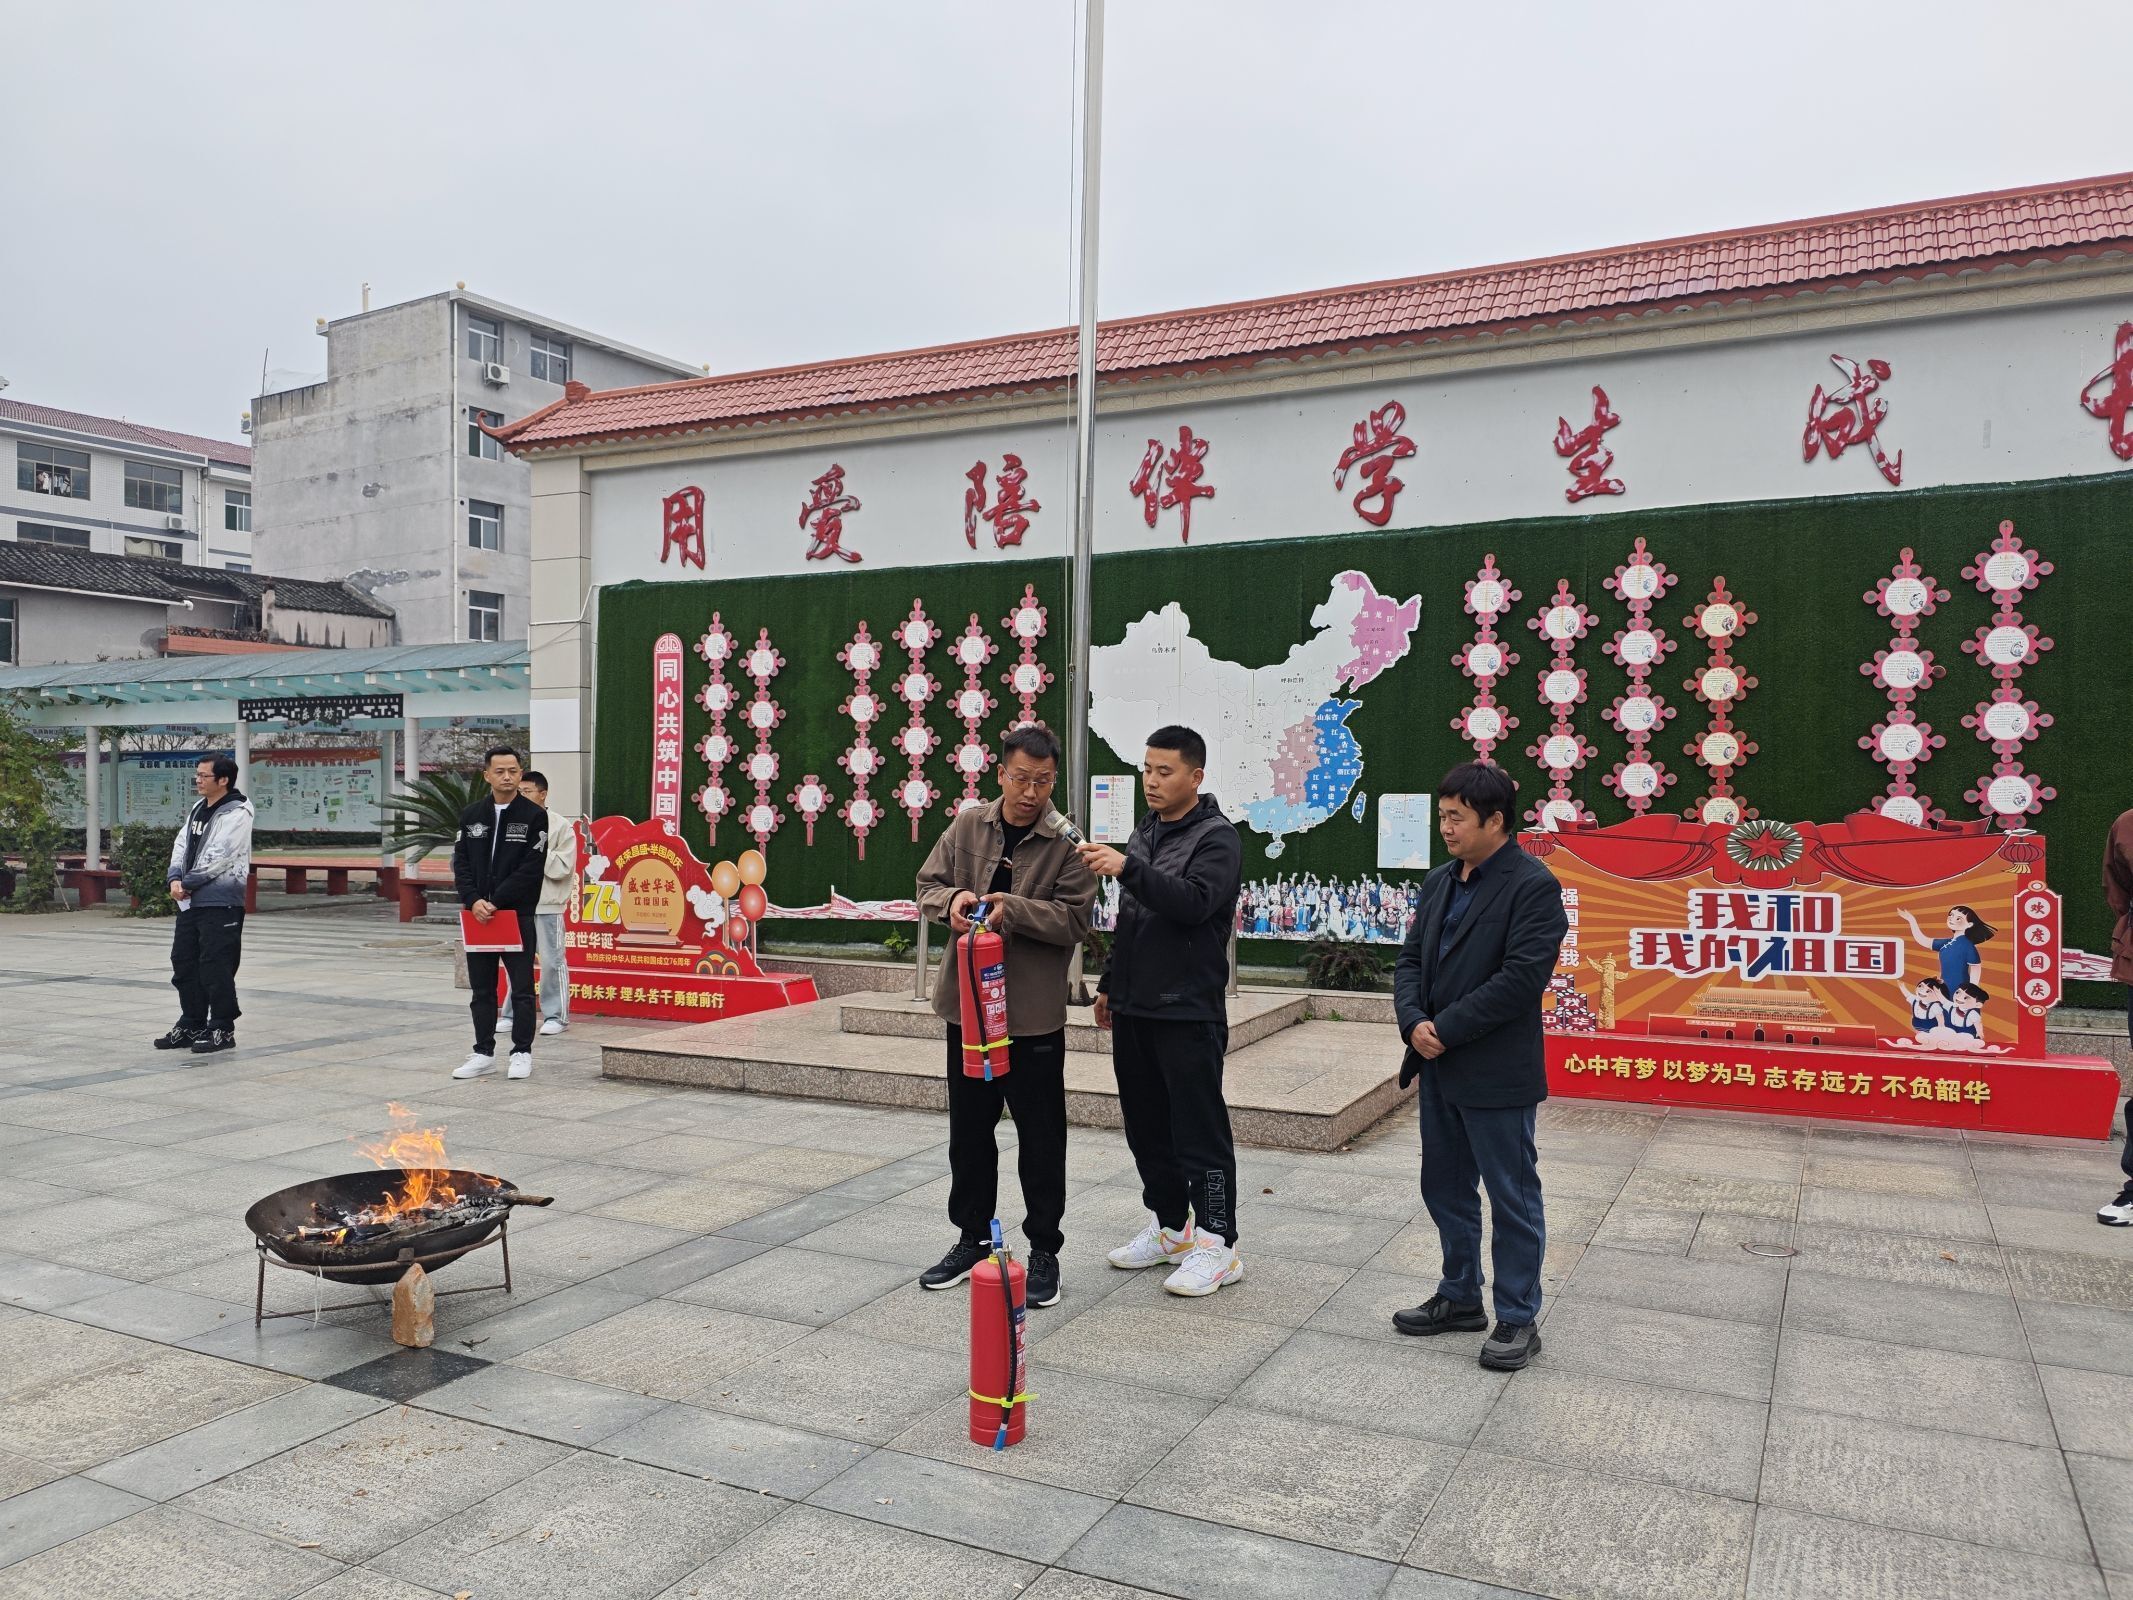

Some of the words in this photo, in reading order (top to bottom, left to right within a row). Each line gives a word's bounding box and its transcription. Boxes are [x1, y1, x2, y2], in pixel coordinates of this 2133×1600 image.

[582, 884, 620, 923] 76
[628, 877, 676, 894] 盛世华诞
[1560, 888, 1580, 968] 强国有我
[1693, 891, 1836, 934] 我和
[565, 931, 614, 950] 盛世华诞
[1634, 931, 1899, 978] 我的祖国
[2030, 901, 2046, 997] 欢度国庆
[569, 983, 617, 1001] 开创未来
[620, 986, 673, 1005] 埋头苦干
[674, 990, 726, 1010] 勇毅前行
[1564, 1053, 1657, 1080] 心中有梦
[1662, 1059, 1757, 1087] 以梦为马
[1763, 1066, 1873, 1096] 志存远方
[1880, 1074, 1992, 1105] 不负韶华
